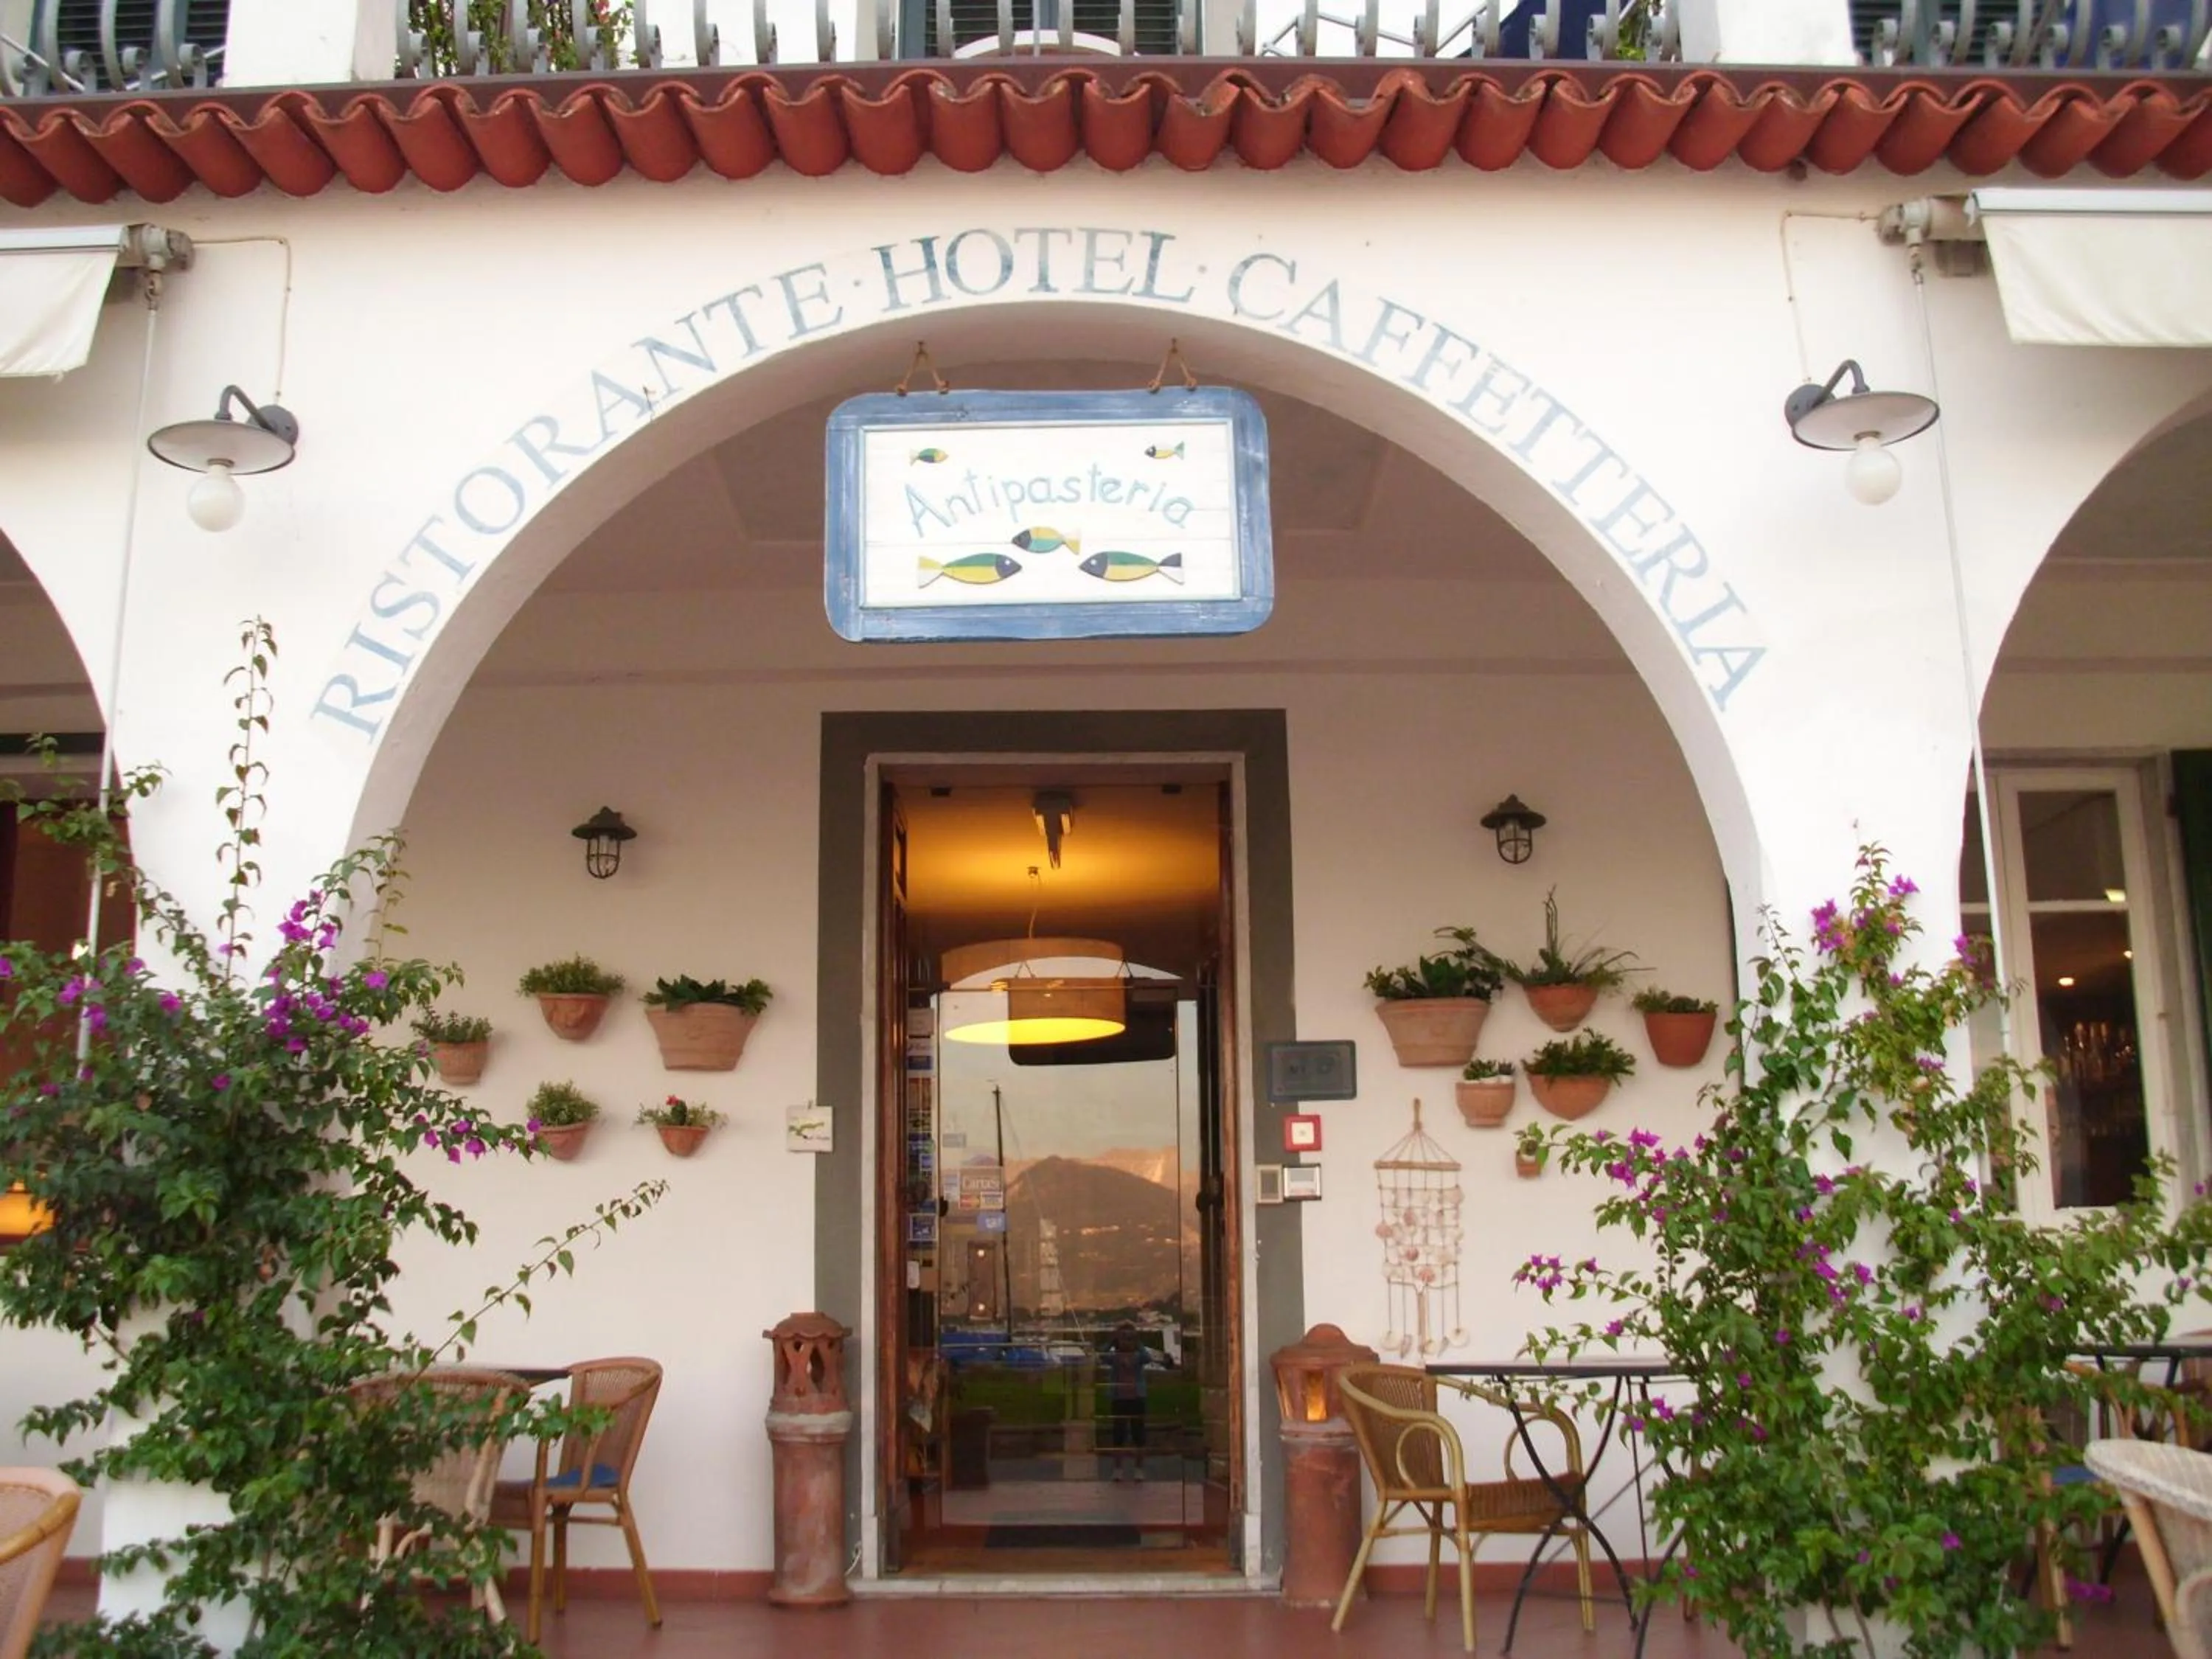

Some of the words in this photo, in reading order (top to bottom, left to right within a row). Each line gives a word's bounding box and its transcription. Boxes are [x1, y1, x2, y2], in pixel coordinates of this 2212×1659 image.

[310, 262, 844, 744] RISTORANTE
[872, 227, 1194, 312] HOTEL
[1227, 252, 1767, 712] CAFFETTERIA
[904, 464, 1195, 538] Antipasteria
